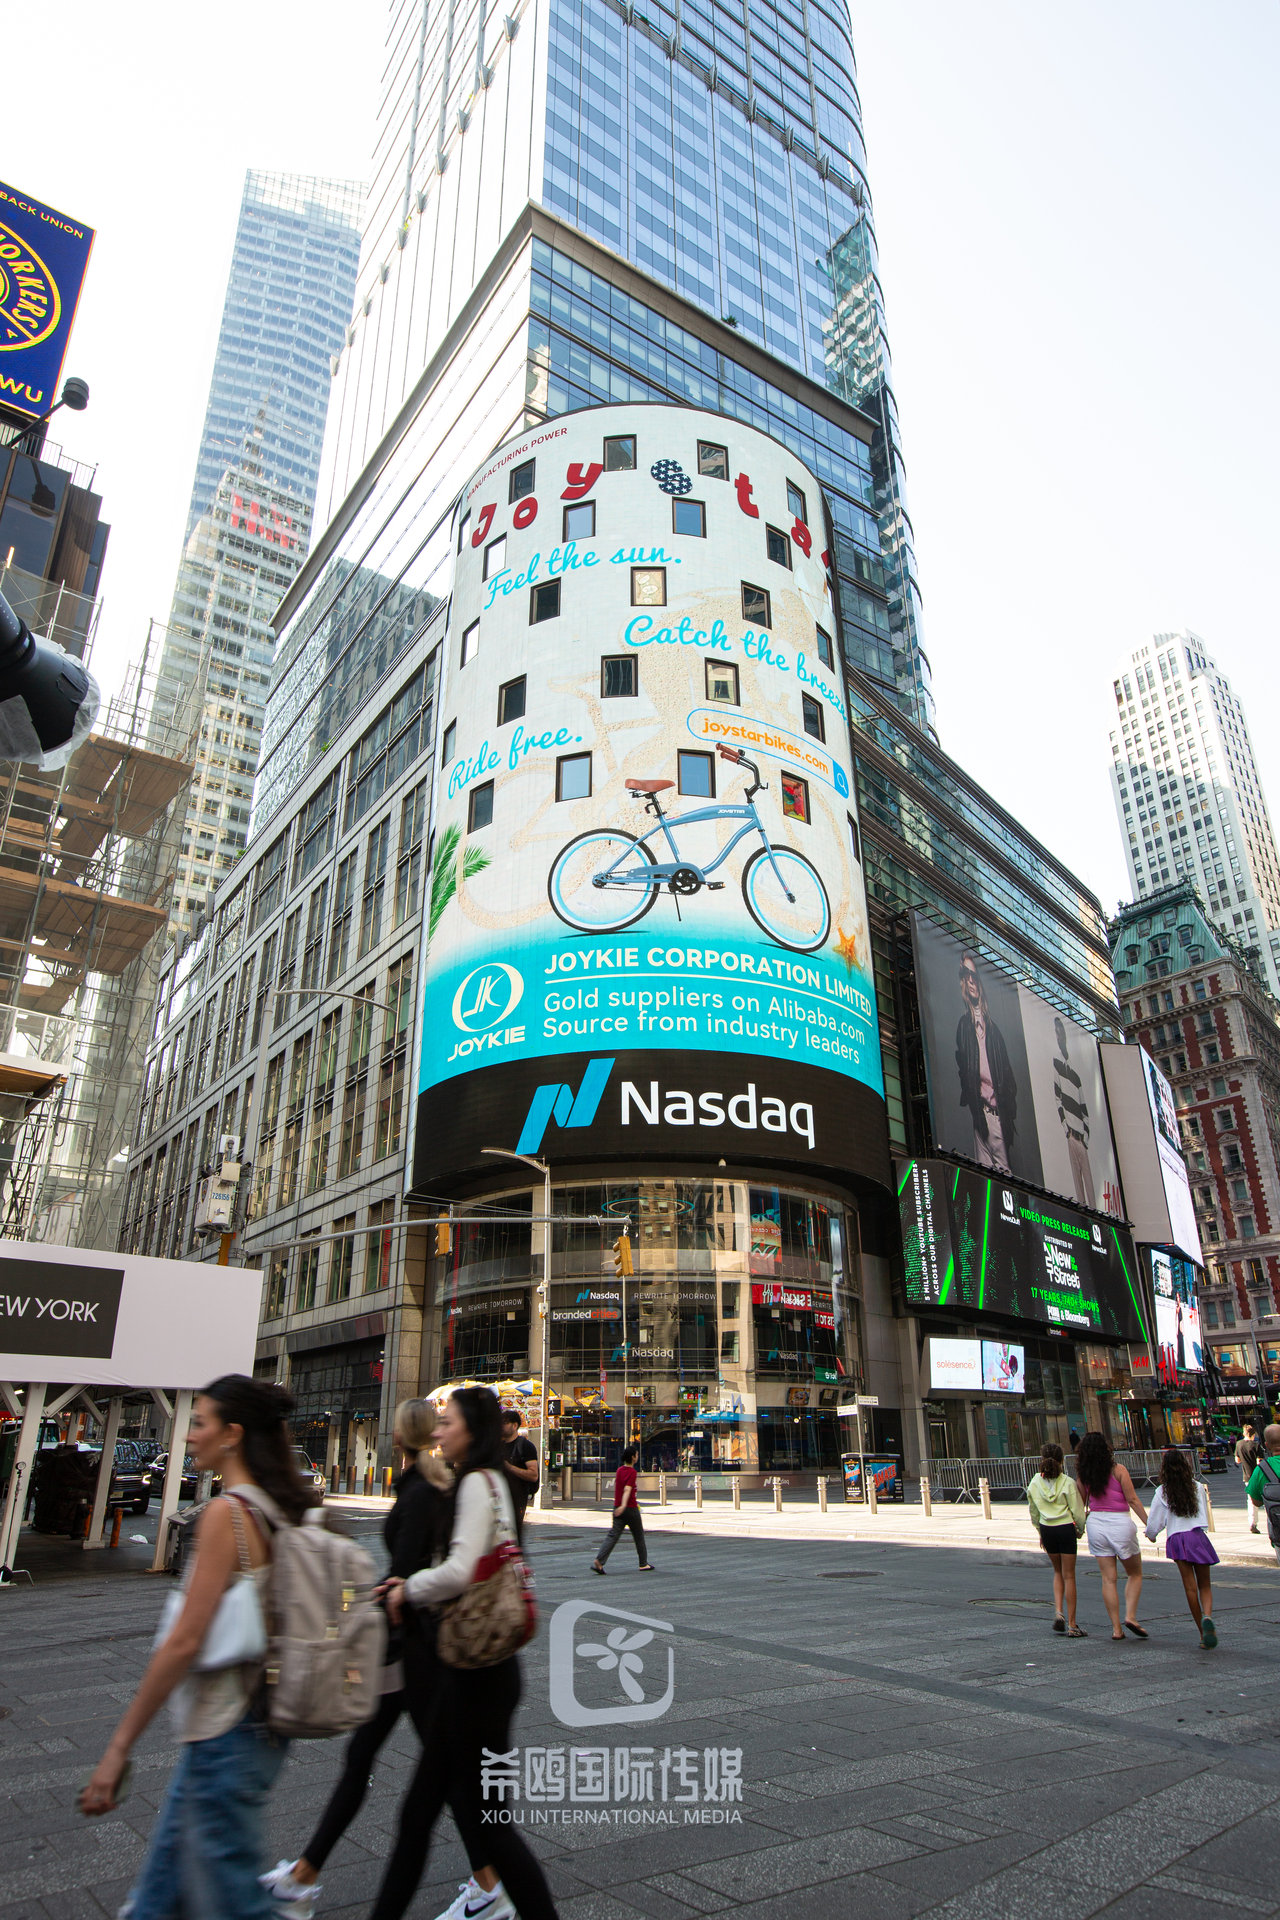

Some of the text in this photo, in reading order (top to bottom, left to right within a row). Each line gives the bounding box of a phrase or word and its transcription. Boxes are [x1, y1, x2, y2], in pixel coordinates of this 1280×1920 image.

[0, 191, 84, 239] BACK UNION
[0, 234, 48, 329] ORKERS
[466, 427, 568, 503] MANUFACTURING POWER
[484, 541, 683, 610] Feel the sun.
[624, 614, 733, 652] Catch
[739, 630, 791, 672] the
[448, 725, 584, 800] Ride free.
[702, 718, 829, 775] joystarbikes.com
[544, 947, 873, 1018] JOYKIE CORPORATION LIMITED
[544, 986, 866, 1046] Gold suppliers on Alibaba.com
[447, 1025, 526, 1063] JOYKIE
[543, 1010, 861, 1065] Source from industry leaders
[621, 1080, 815, 1150] Nasdaq
[912, 1163, 923, 1215] SUBSCRIBERS
[922, 1169, 932, 1210] CHANNELS
[917, 1217, 926, 1254] YOUTUBE
[926, 1211, 935, 1243] DIGITAL
[1019, 1206, 1090, 1241] VIDEO PRESS RELEASES
[1044, 1234, 1073, 1250] DISTRIBUTED BY
[921, 1256, 930, 1294] MILLION+
[1050, 1244, 1071, 1269] New
[931, 1263, 940, 1296] ACROSS
[1054, 1265, 1081, 1289] Street
[34, 1297, 100, 1322] YORK
[468, 1302, 488, 1312] REWRITE
[489, 1298, 523, 1308] TOMORROW
[552, 1308, 618, 1320] brandedcities
[590, 1292, 717, 1301] Nasdaq REWRITE TOMORROW
[1030, 1286, 1038, 1299] 17
[1079, 1296, 1100, 1313] SHOWS
[1064, 1309, 1091, 1328] Bloomberg
[632, 1346, 674, 1360] Nasdaq
